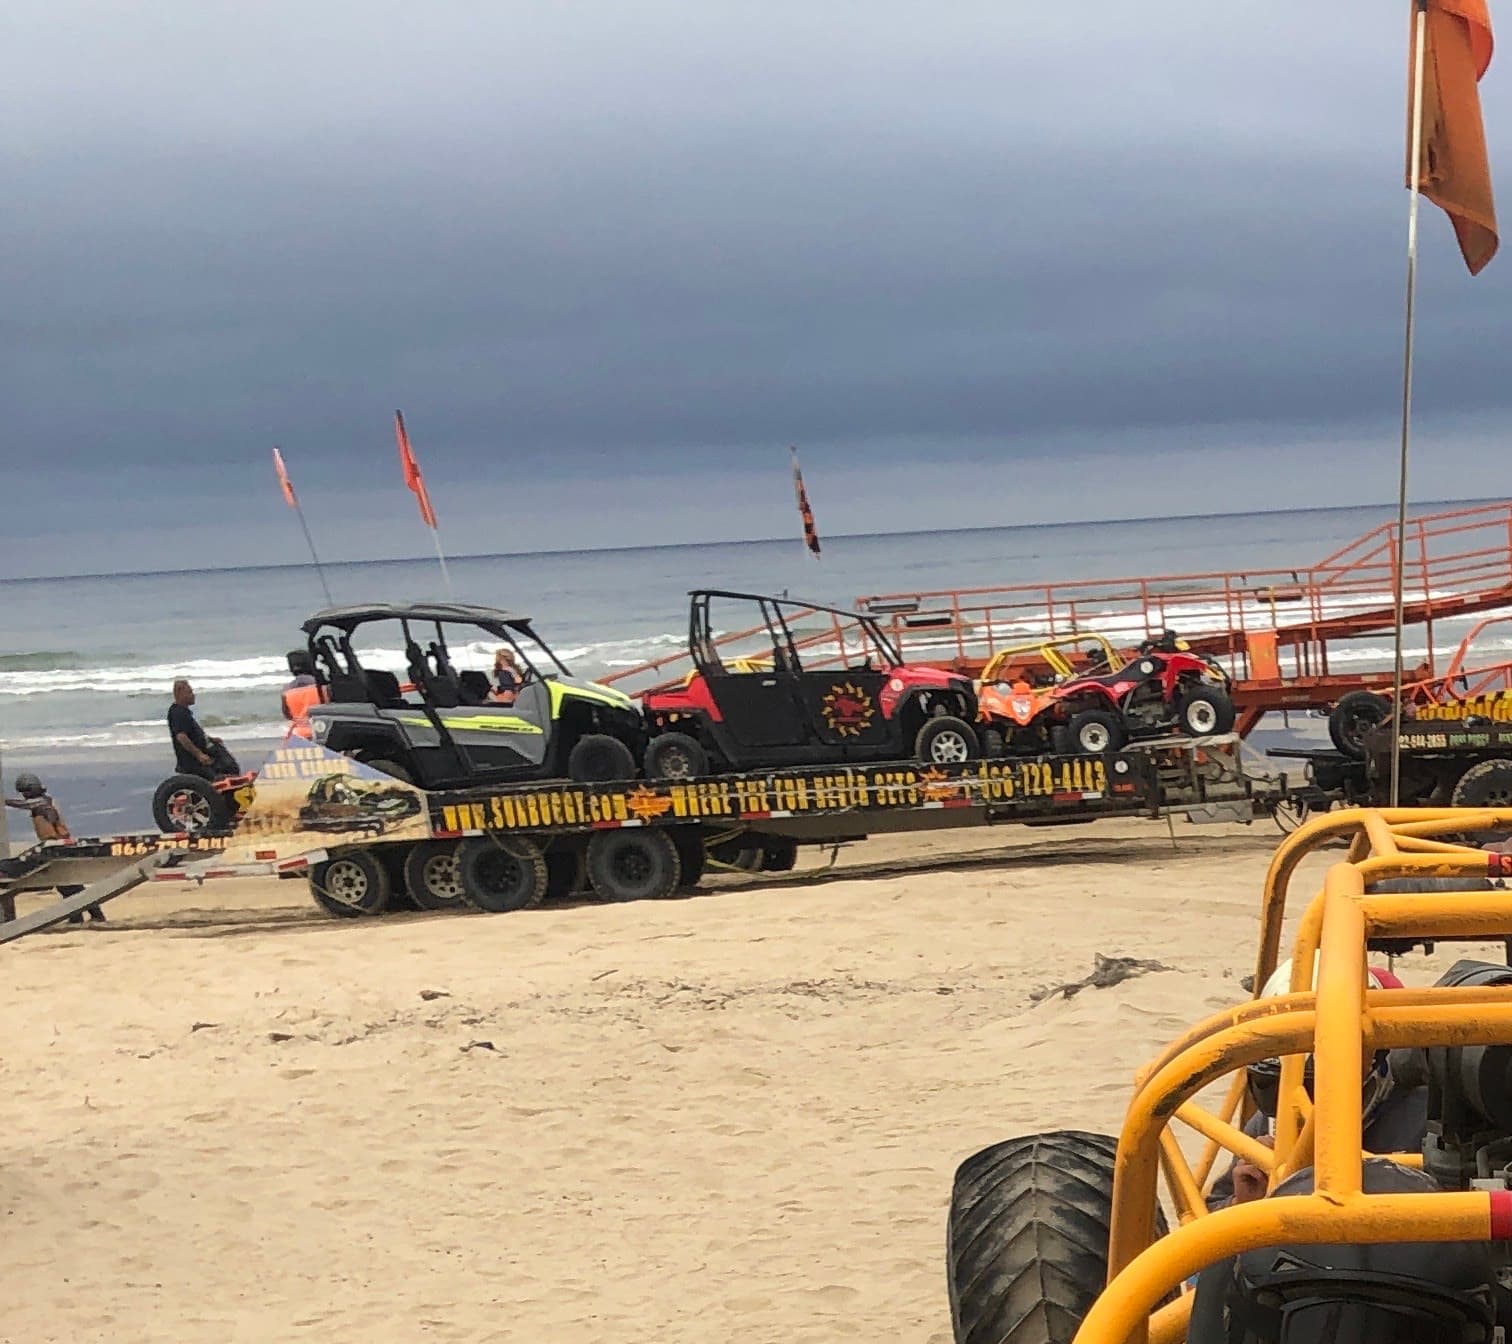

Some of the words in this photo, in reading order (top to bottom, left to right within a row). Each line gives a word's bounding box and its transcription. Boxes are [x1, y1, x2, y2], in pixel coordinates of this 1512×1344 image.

[670, 782, 732, 817] WHERE
[735, 780, 770, 812] THE
[774, 777, 809, 810] FUN
[814, 774, 869, 808] NEVER
[874, 771, 918, 805] SETS
